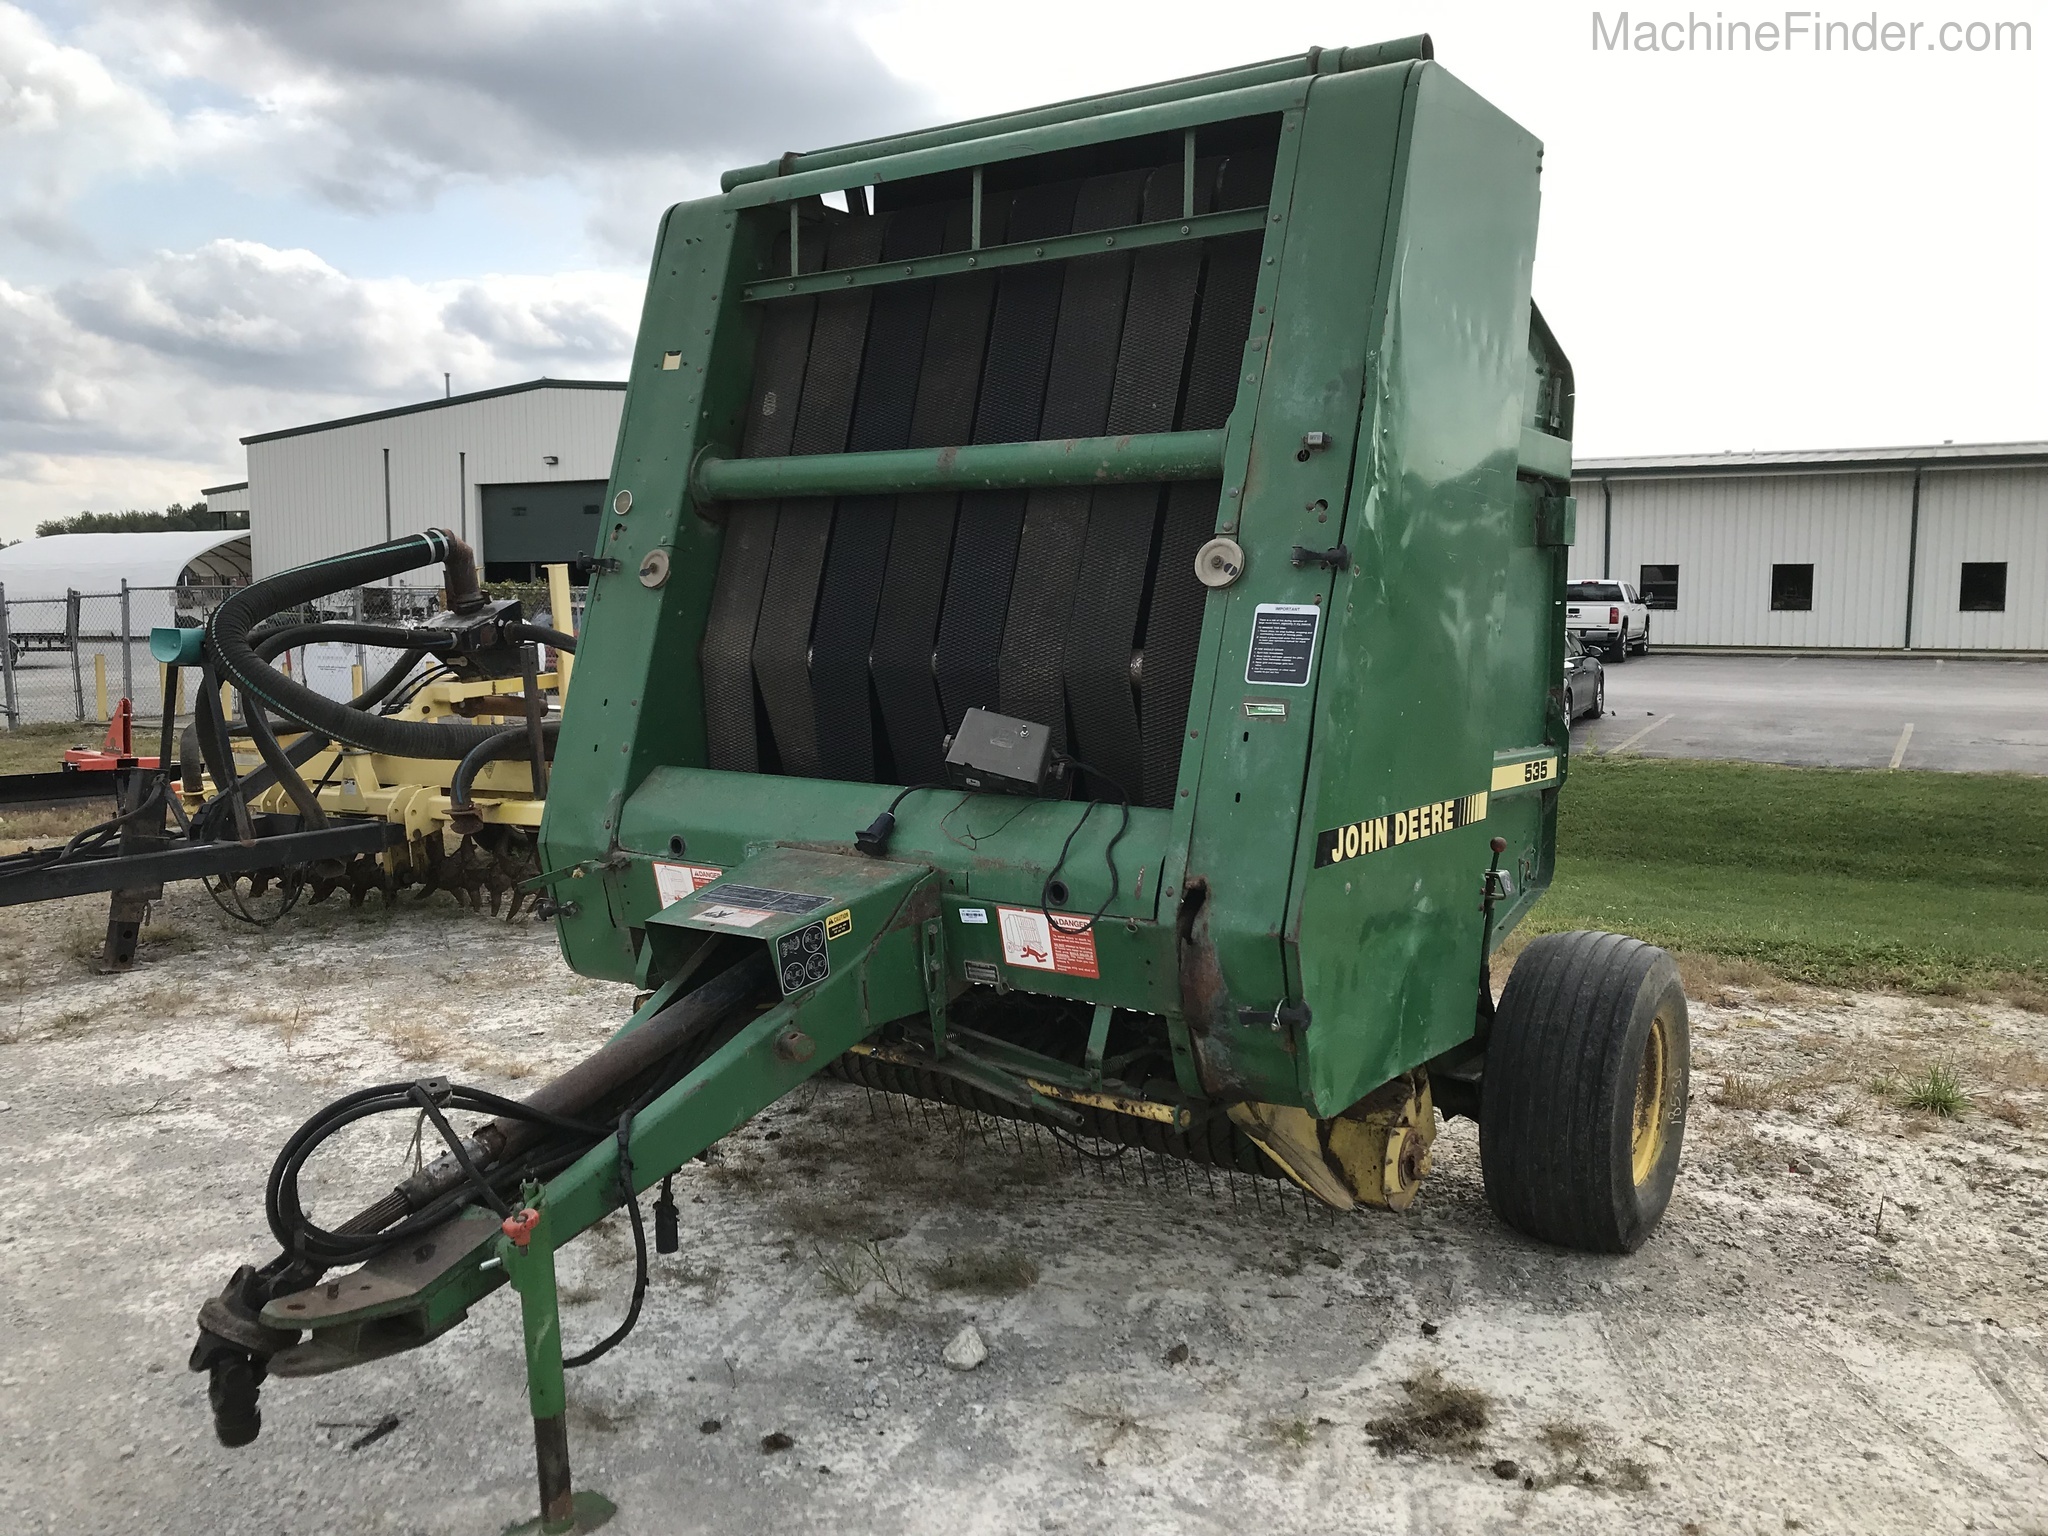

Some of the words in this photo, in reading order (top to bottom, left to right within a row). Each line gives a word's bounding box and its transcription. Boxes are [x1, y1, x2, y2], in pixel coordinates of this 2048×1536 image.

[1524, 760, 1548, 783] 535
[1331, 816, 1388, 863] JOHN
[1394, 800, 1455, 845] DEERE
